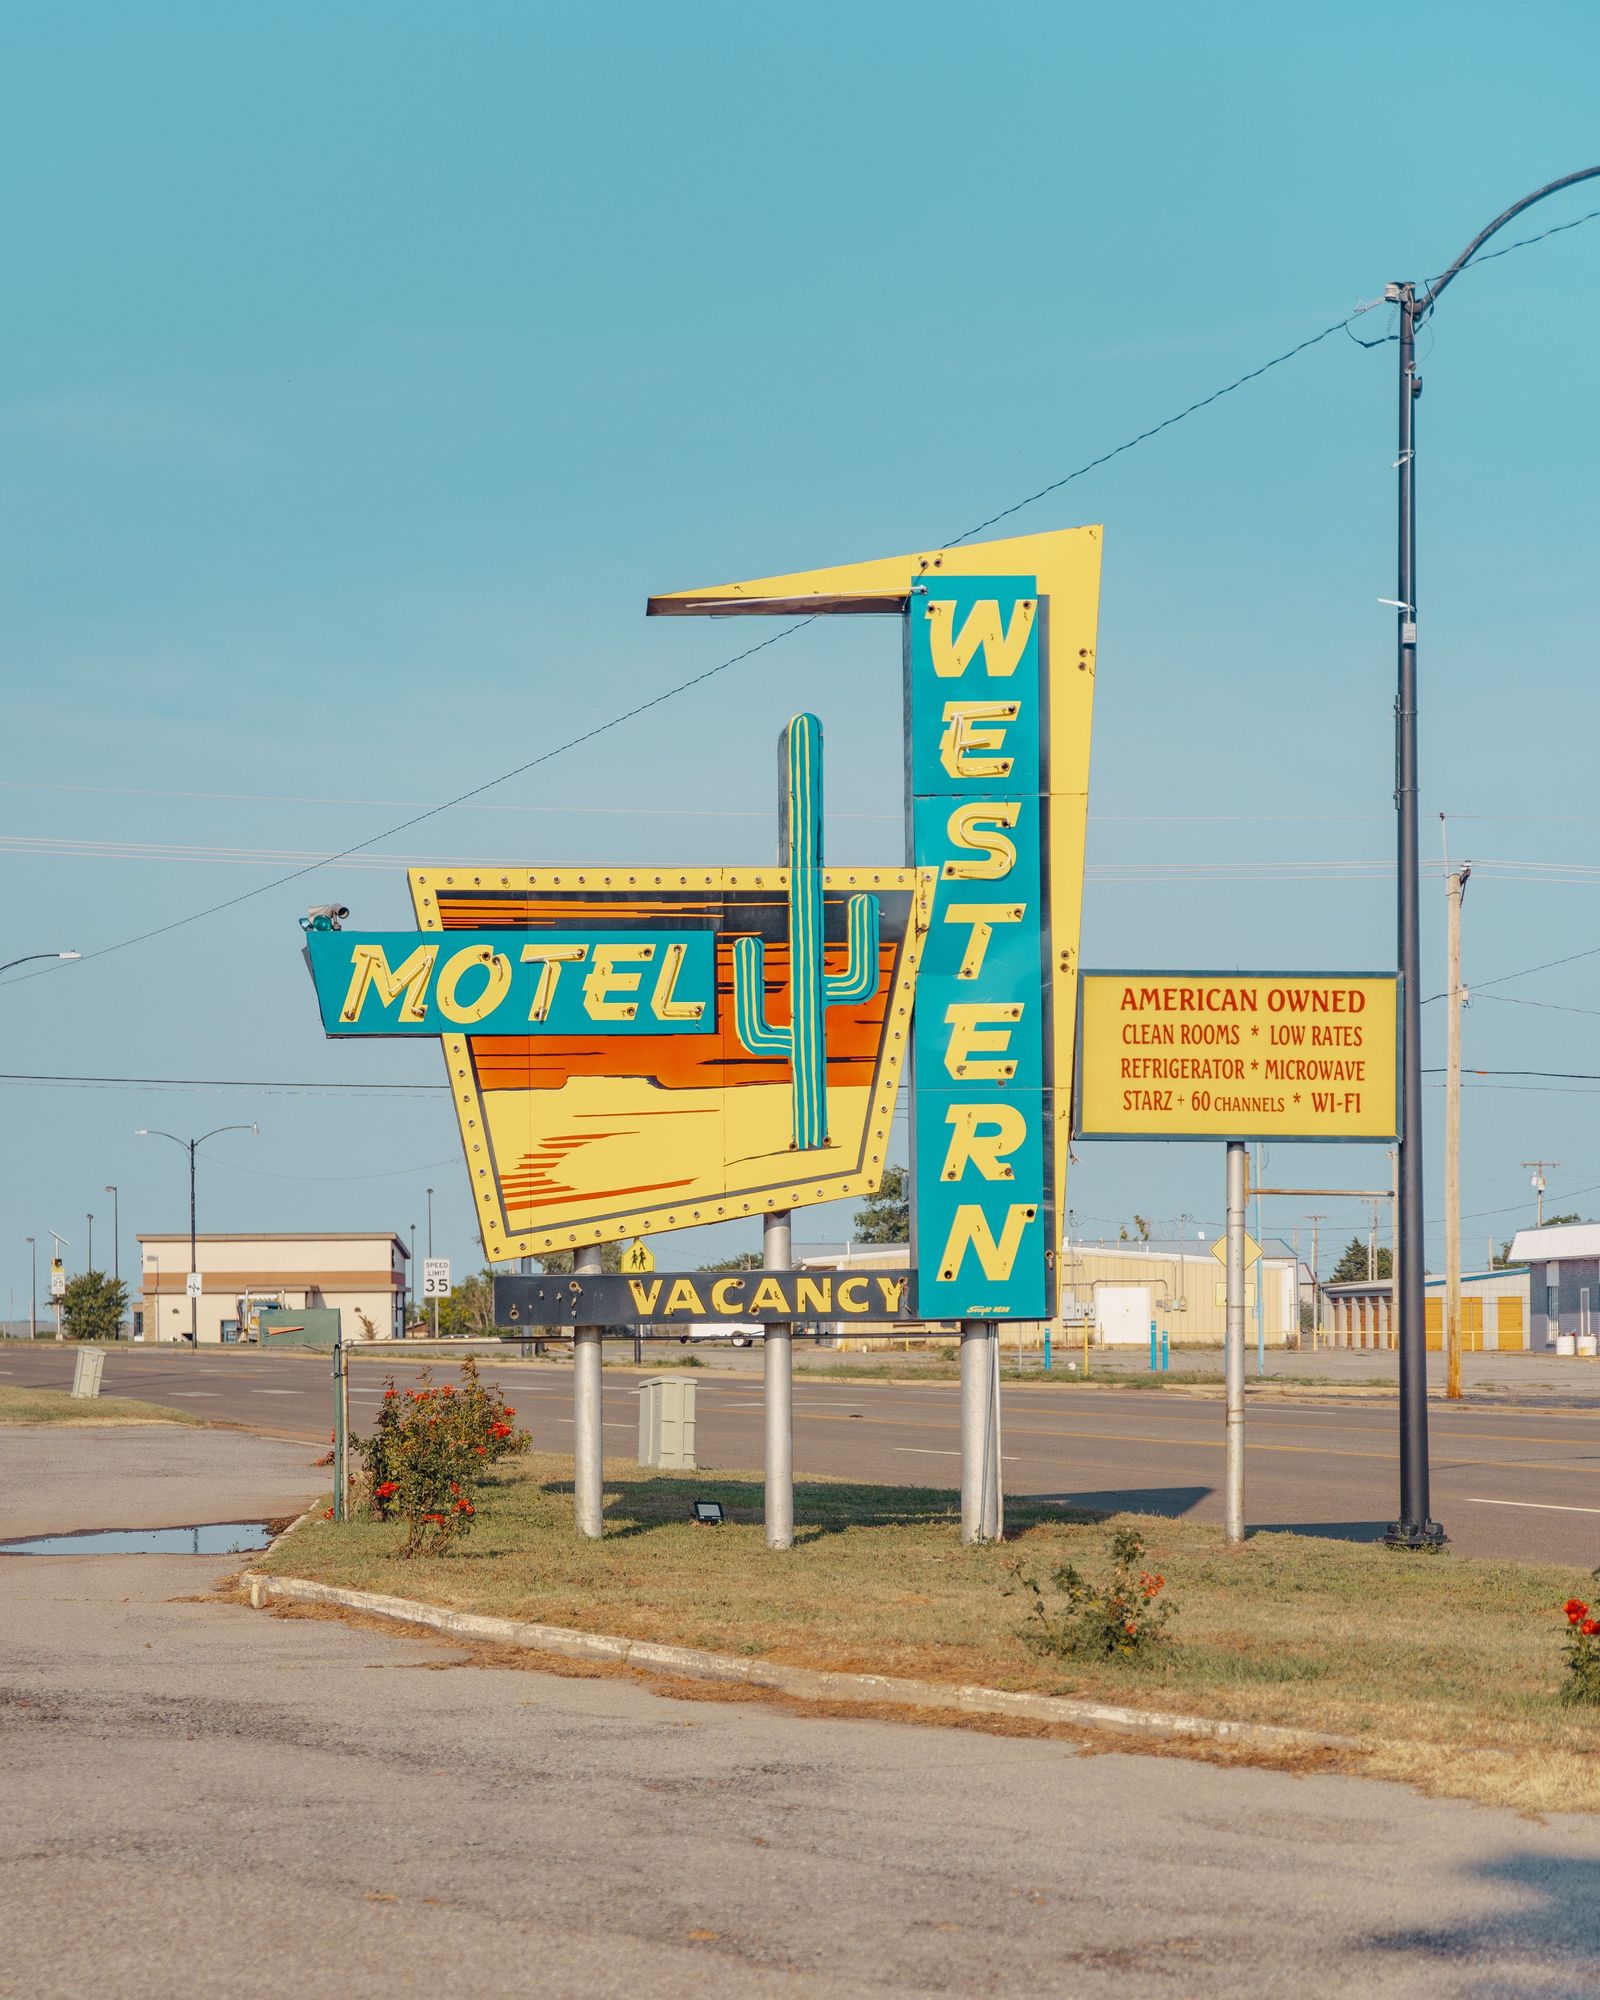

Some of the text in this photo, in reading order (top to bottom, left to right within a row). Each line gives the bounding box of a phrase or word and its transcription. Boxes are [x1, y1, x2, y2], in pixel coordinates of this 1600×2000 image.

[925, 599, 1038, 1282] WESTERN
[339, 944, 706, 1024] MOTEL
[1120, 987, 1366, 1014] AMERICAN OWNED
[1122, 1023, 1363, 1047] CLEAN ROOMS LOW RATES
[1121, 1057, 1365, 1082] REFRIGERATOR MICROWAVE
[1123, 1089, 1173, 1111] STARZ
[1190, 1090, 1211, 1112] 60
[1213, 1096, 1286, 1113] CHANNELS
[1311, 1091, 1362, 1114] WI-FI
[425, 1279, 448, 1292] 35
[628, 1277, 908, 1315] VACANCY
